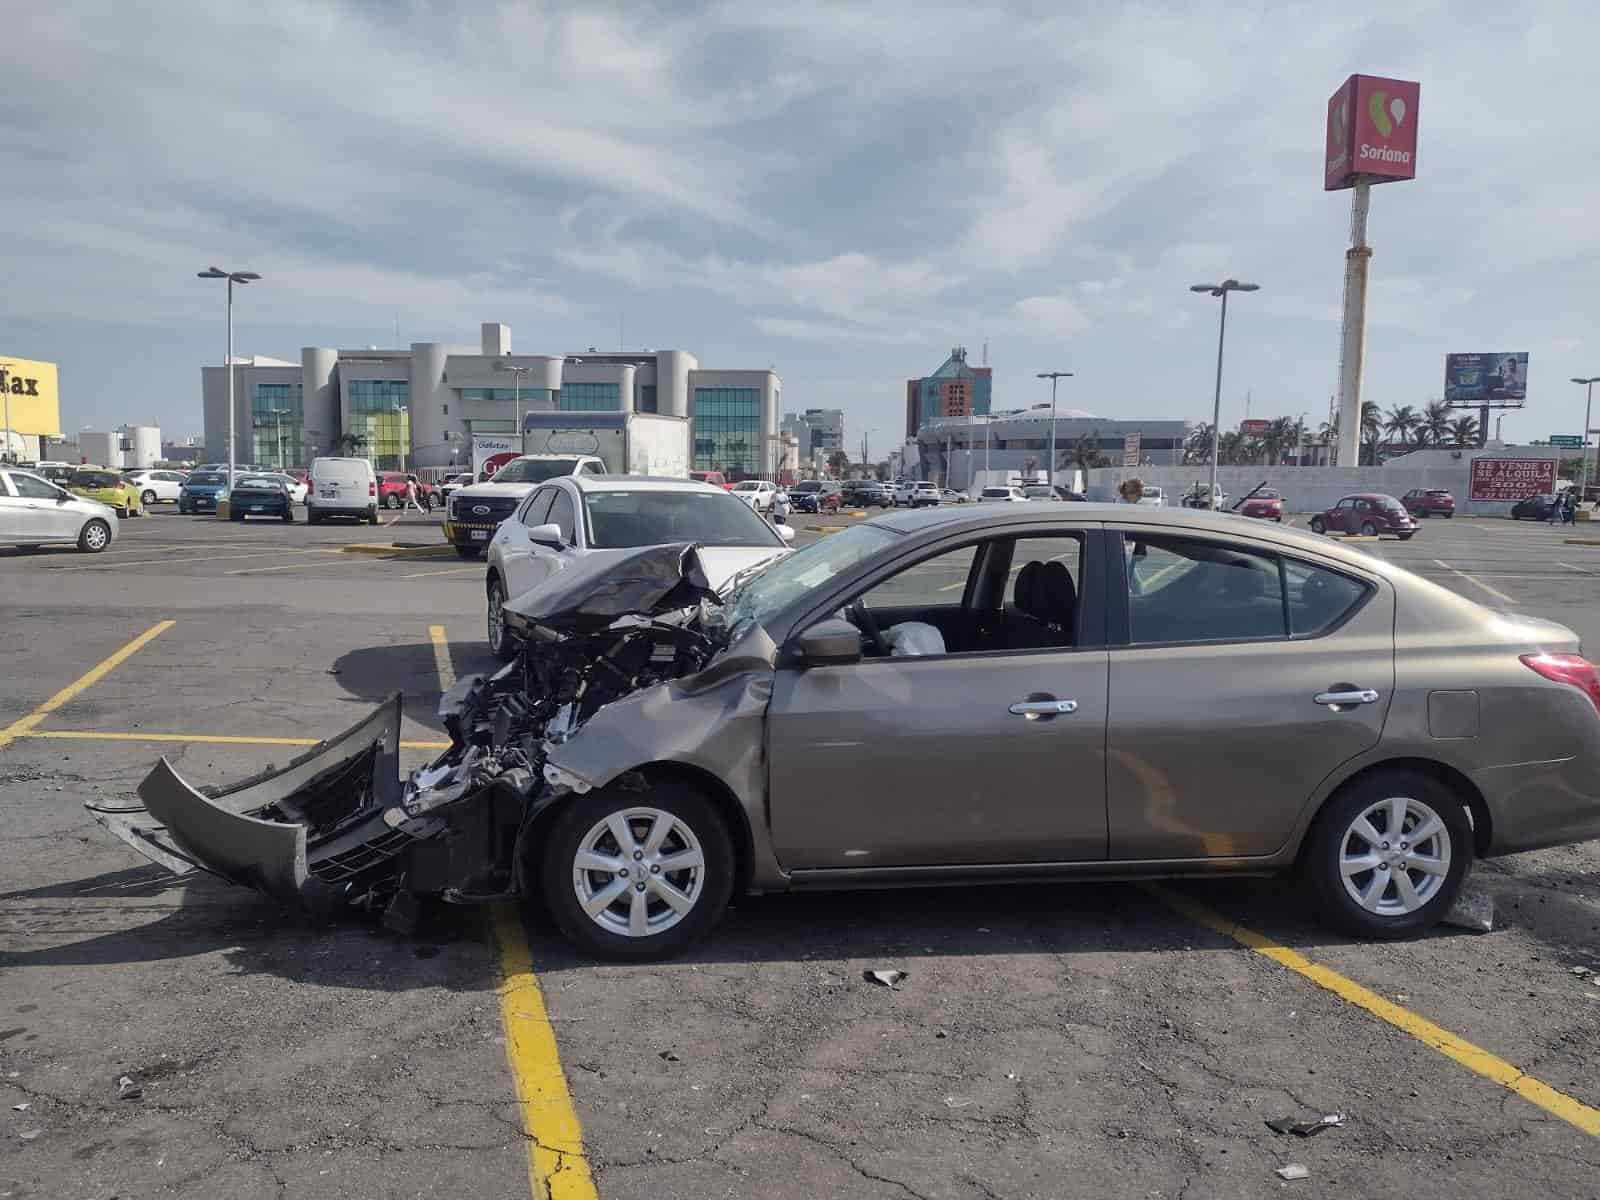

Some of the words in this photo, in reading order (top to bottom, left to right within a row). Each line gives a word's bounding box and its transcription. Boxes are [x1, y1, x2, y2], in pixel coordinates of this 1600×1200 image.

[1359, 144, 1410, 162] Soriana
[1499, 462, 1538, 470] VENDE
[1495, 470, 1551, 478] ALQUILA
